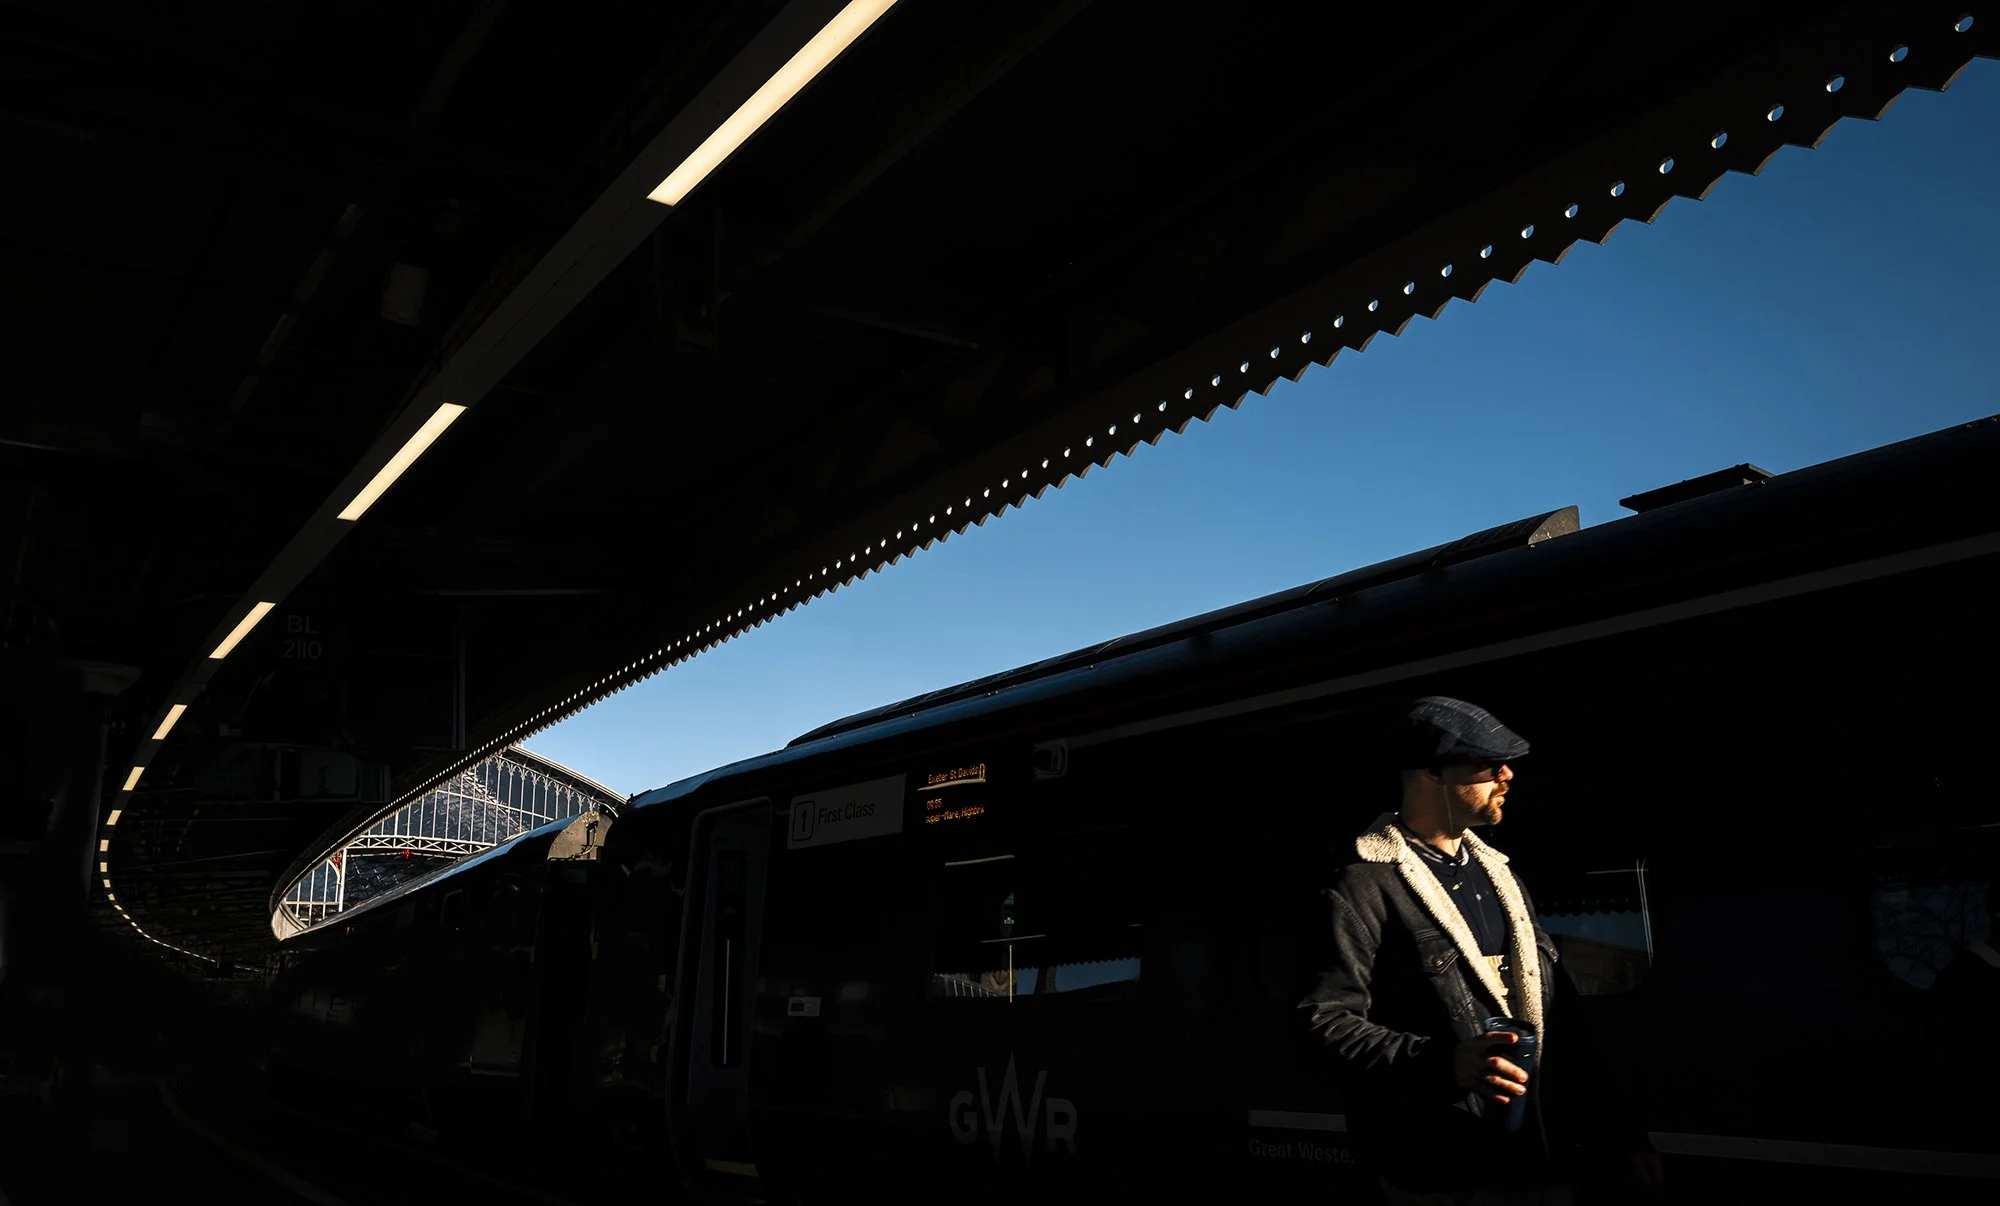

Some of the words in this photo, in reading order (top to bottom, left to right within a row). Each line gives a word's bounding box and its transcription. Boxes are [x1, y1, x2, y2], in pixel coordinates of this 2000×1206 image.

[287, 614, 320, 635] BL
[283, 638, 322, 660] 2110
[928, 773, 948, 785] Exeter
[950, 769, 957, 780] St
[958, 765, 979, 778] Davids
[800, 809, 807, 833] 1
[818, 806, 842, 825] First
[844, 800, 876, 820] Class
[949, 1050, 1080, 1169] GWR
[1248, 1138, 1295, 1161] Great
